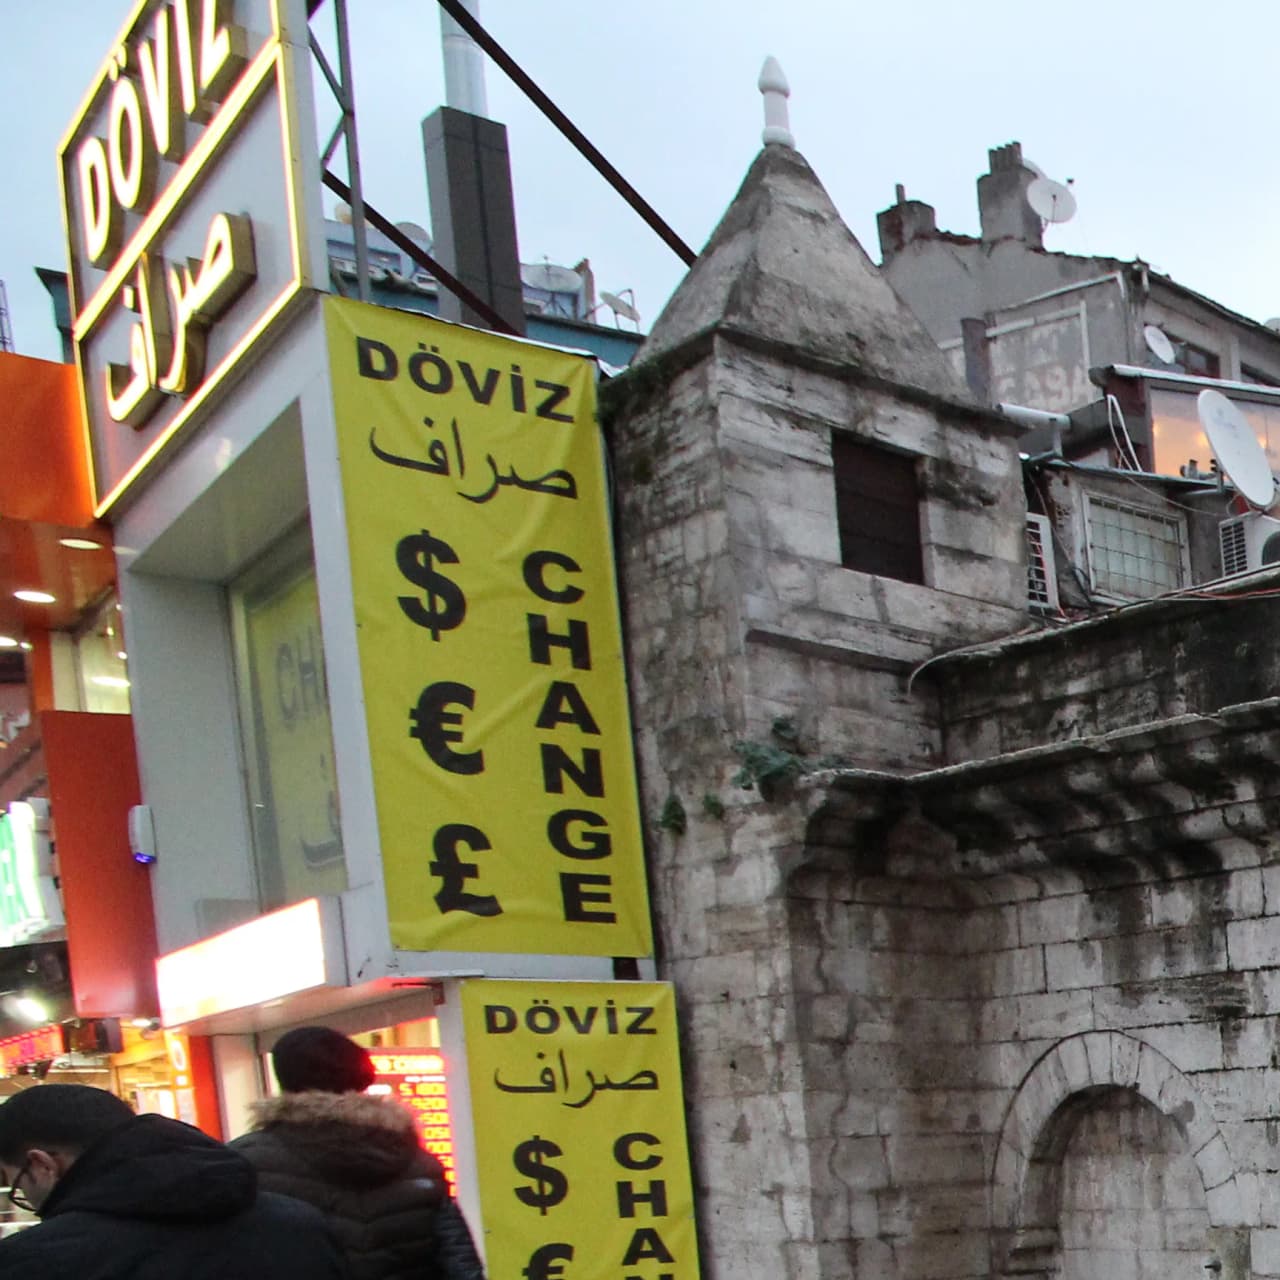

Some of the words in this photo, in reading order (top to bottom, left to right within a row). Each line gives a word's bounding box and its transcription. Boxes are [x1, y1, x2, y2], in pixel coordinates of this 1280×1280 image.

[356, 336, 575, 424] DÖVİZ
[369, 416, 578, 504] صراف
[395, 528, 468, 642] $
[409, 681, 485, 775] €
[521, 550, 617, 924] CHANGE
[429, 823, 504, 917] £
[484, 999, 657, 1036] DÖVİZ
[494, 1049, 659, 1108] صراف
[512, 1134, 569, 1217] $
